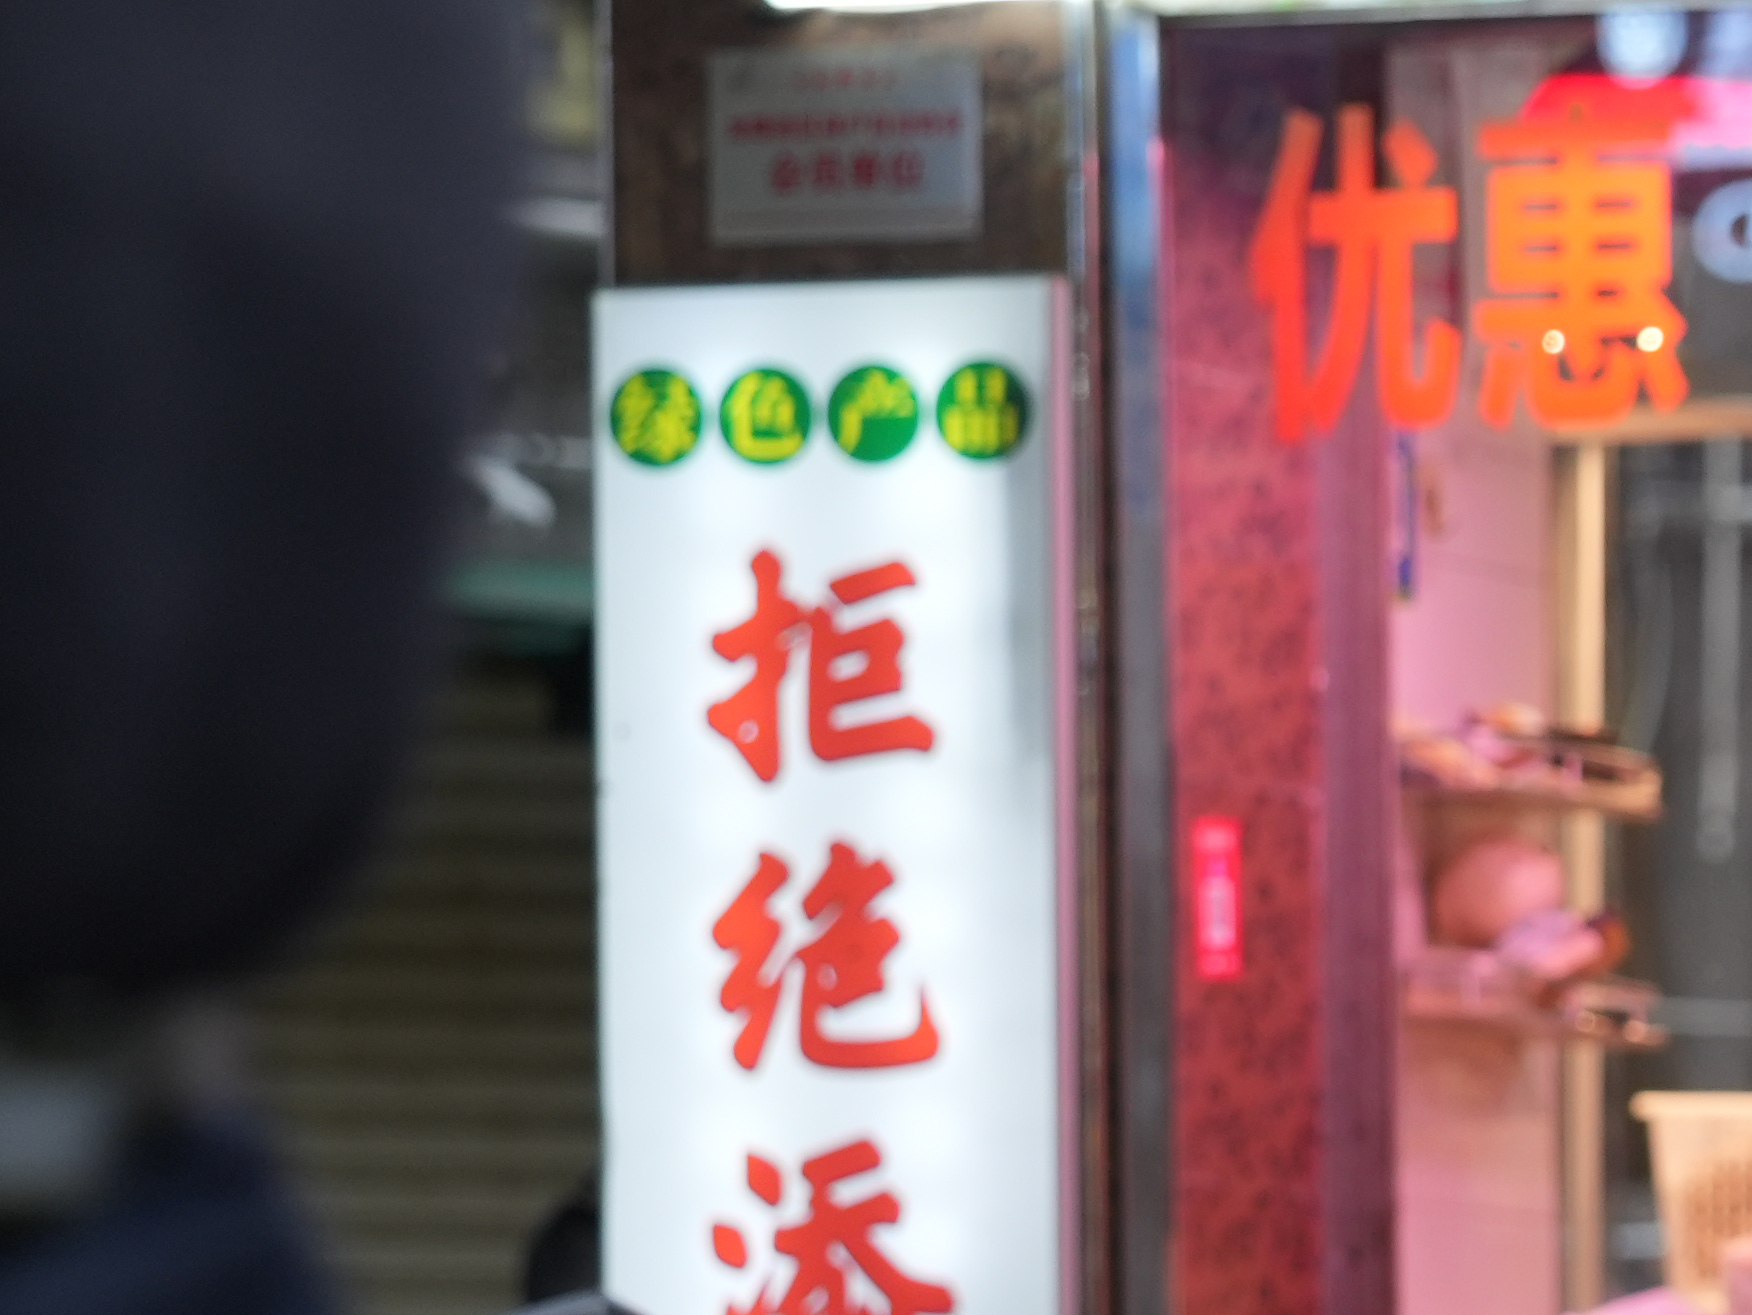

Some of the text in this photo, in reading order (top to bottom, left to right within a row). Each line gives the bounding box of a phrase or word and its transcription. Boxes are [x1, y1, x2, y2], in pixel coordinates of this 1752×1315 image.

[1250, 101, 1690, 446] 优惠
[614, 364, 1020, 464] 绿色产品
